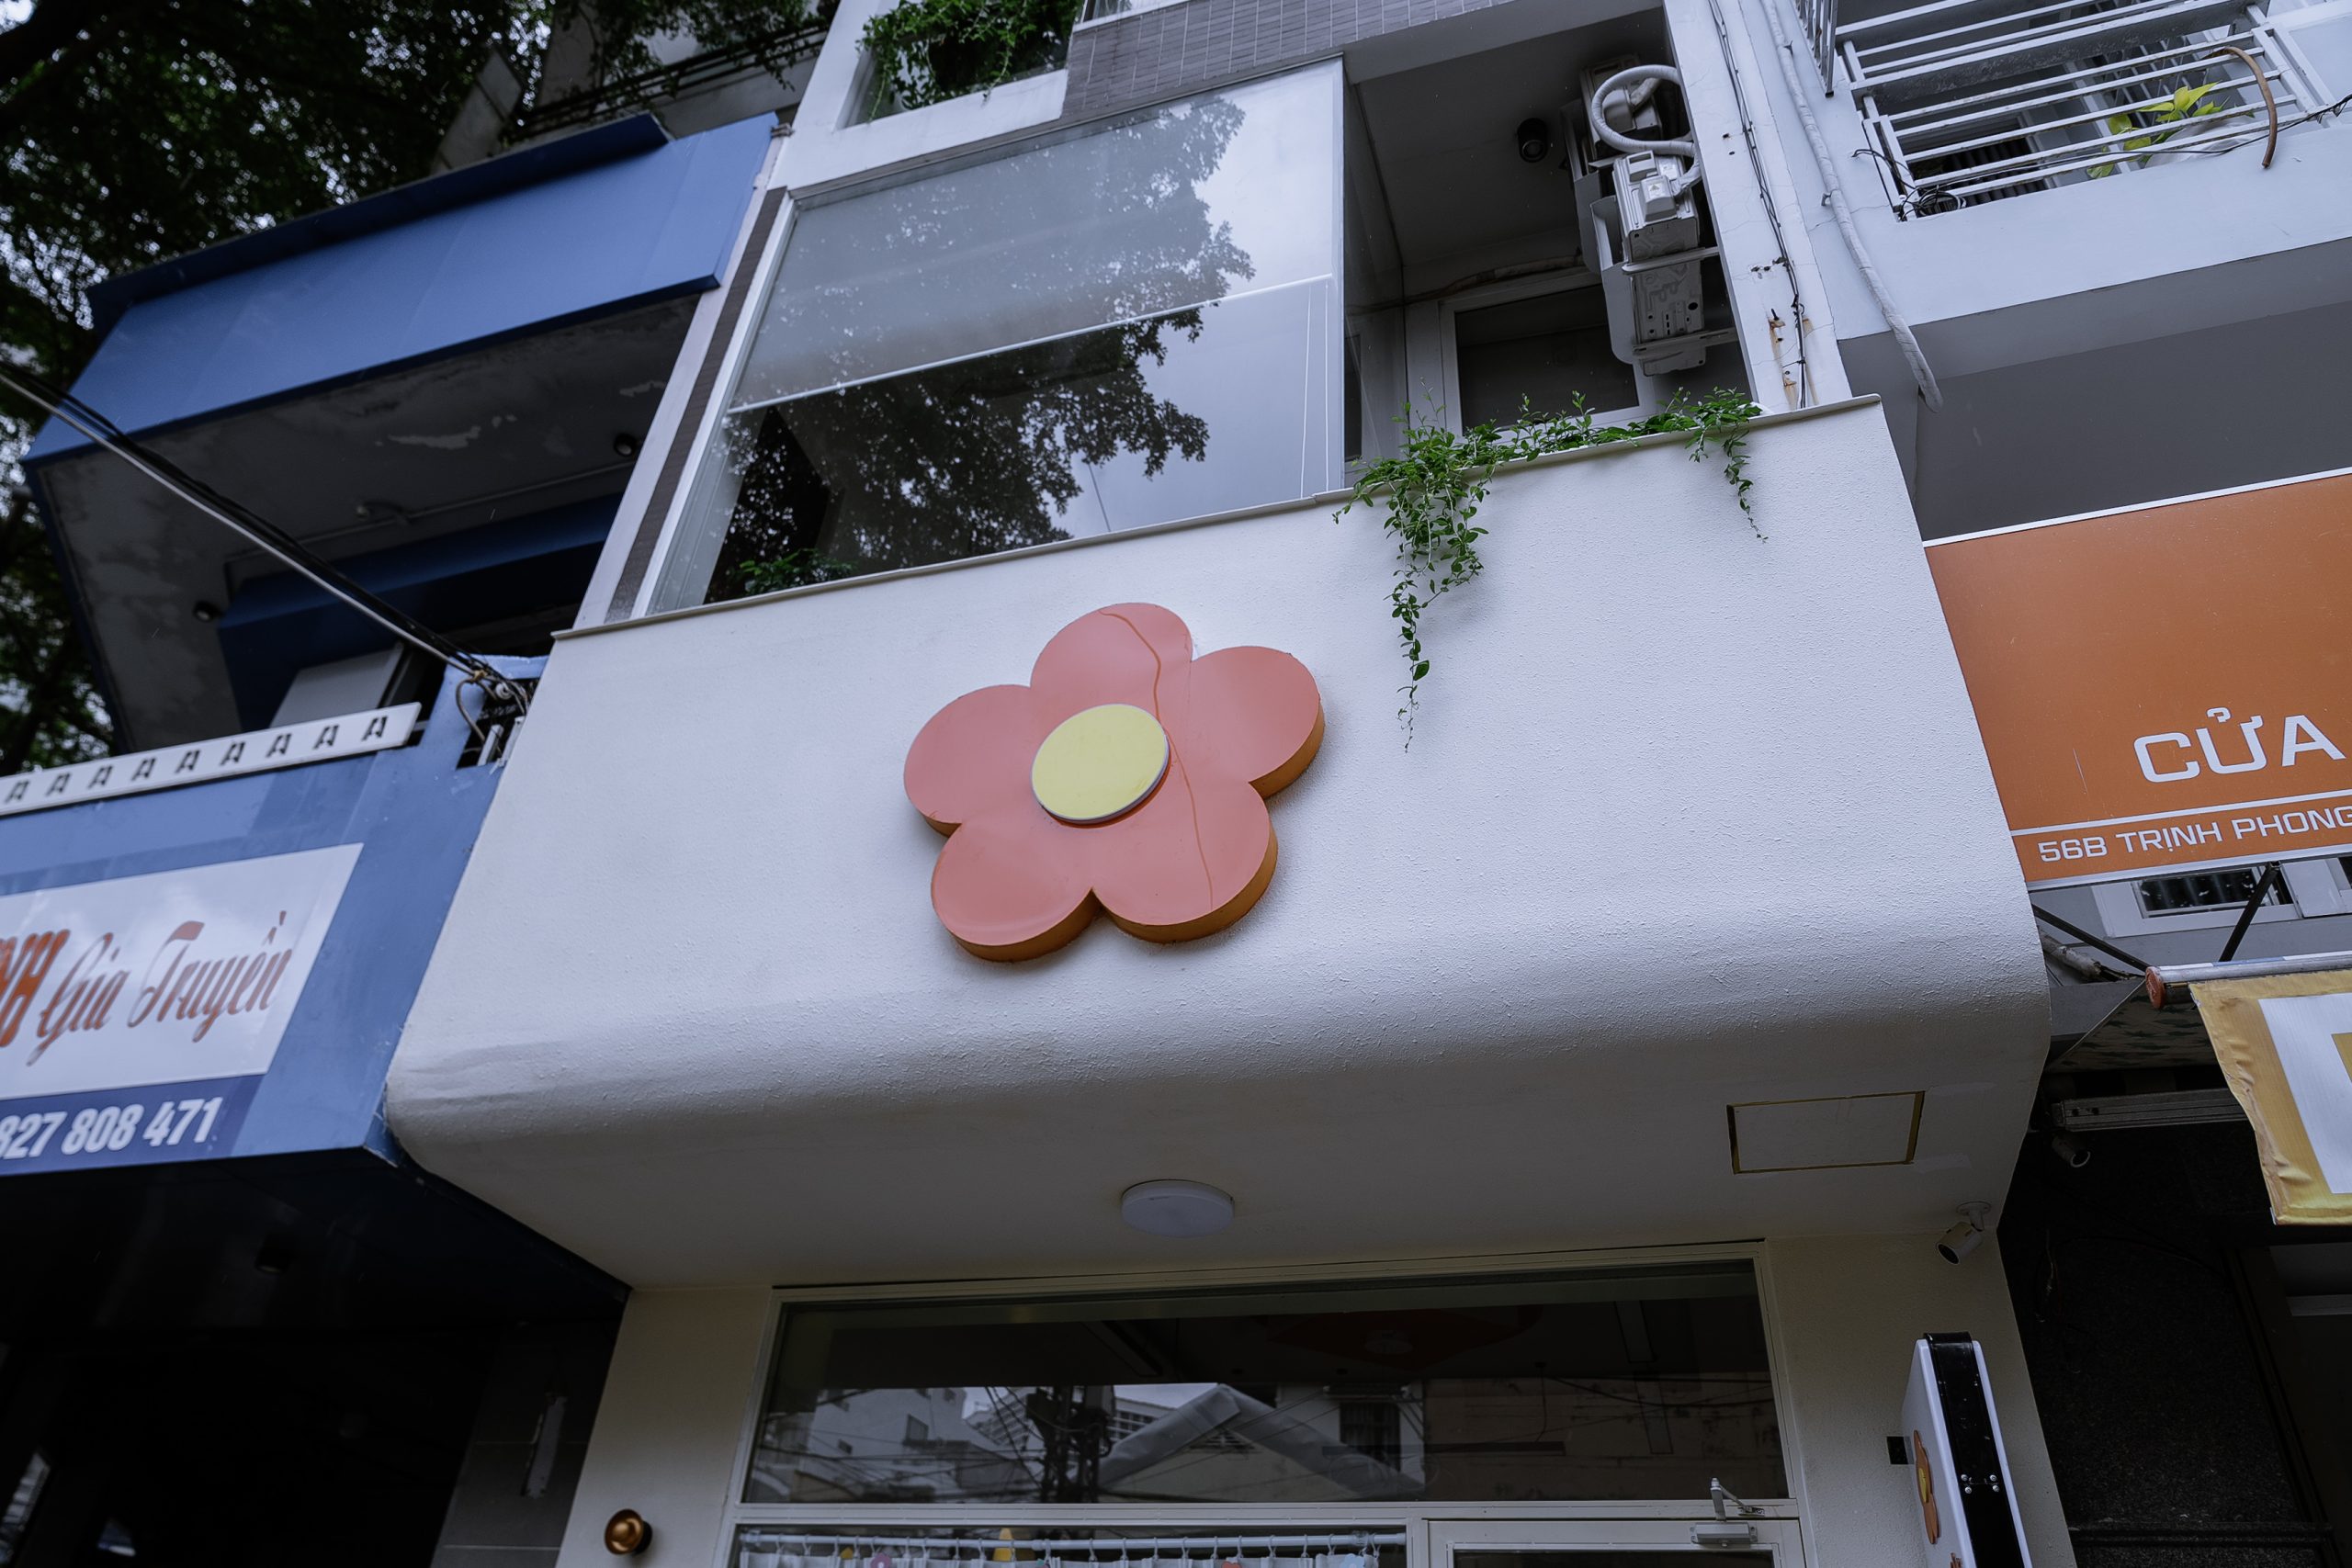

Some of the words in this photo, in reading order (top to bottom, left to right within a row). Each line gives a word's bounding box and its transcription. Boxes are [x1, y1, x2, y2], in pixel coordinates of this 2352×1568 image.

[2133, 706, 2346, 783] CỬA
[2038, 836, 2108, 862] 56B
[2116, 821, 2223, 853] TRỊNH
[2232, 805, 2352, 840] PHONG
[26, 931, 130, 1066] Gia
[0, 1111, 68, 1160] 827
[61, 1103, 145, 1156] 808
[141, 1096, 223, 1147] 471
